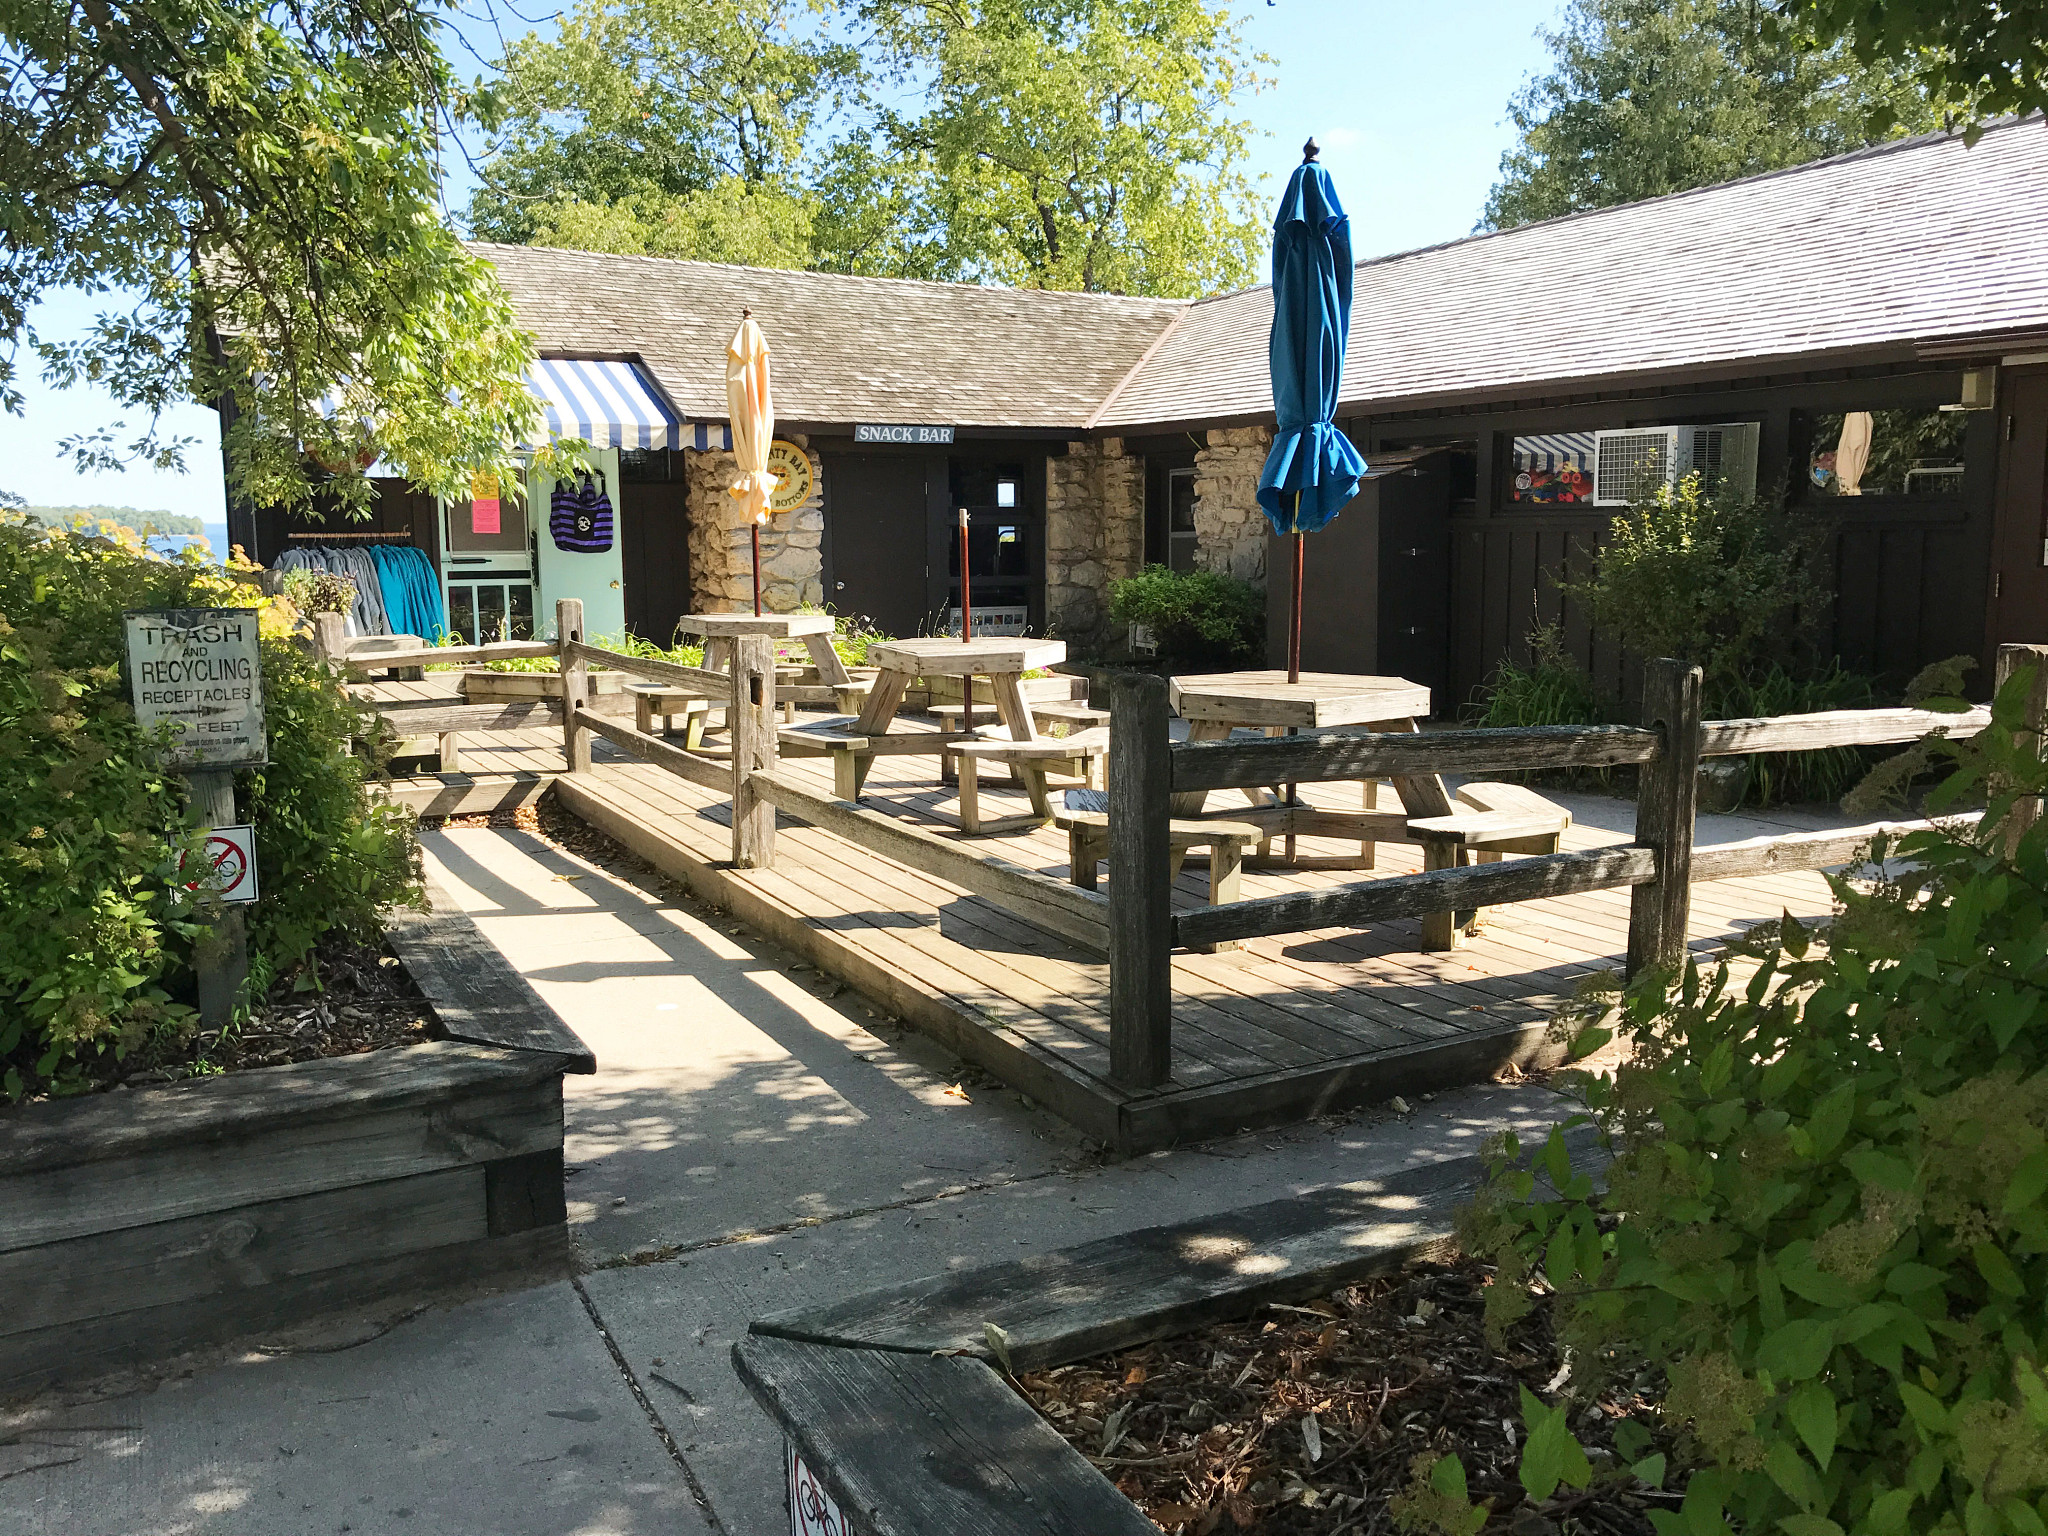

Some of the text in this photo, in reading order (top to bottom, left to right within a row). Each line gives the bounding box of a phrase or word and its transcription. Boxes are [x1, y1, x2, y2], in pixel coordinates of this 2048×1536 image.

[859, 426, 951, 442] SNACK BAR
[789, 455, 808, 476] BAY
[140, 624, 243, 645] TRASH
[182, 647, 208, 657] AND
[141, 657, 251, 684] RECYCLING
[143, 687, 251, 704] RECEPTACLES
[196, 720, 244, 733] FEET
